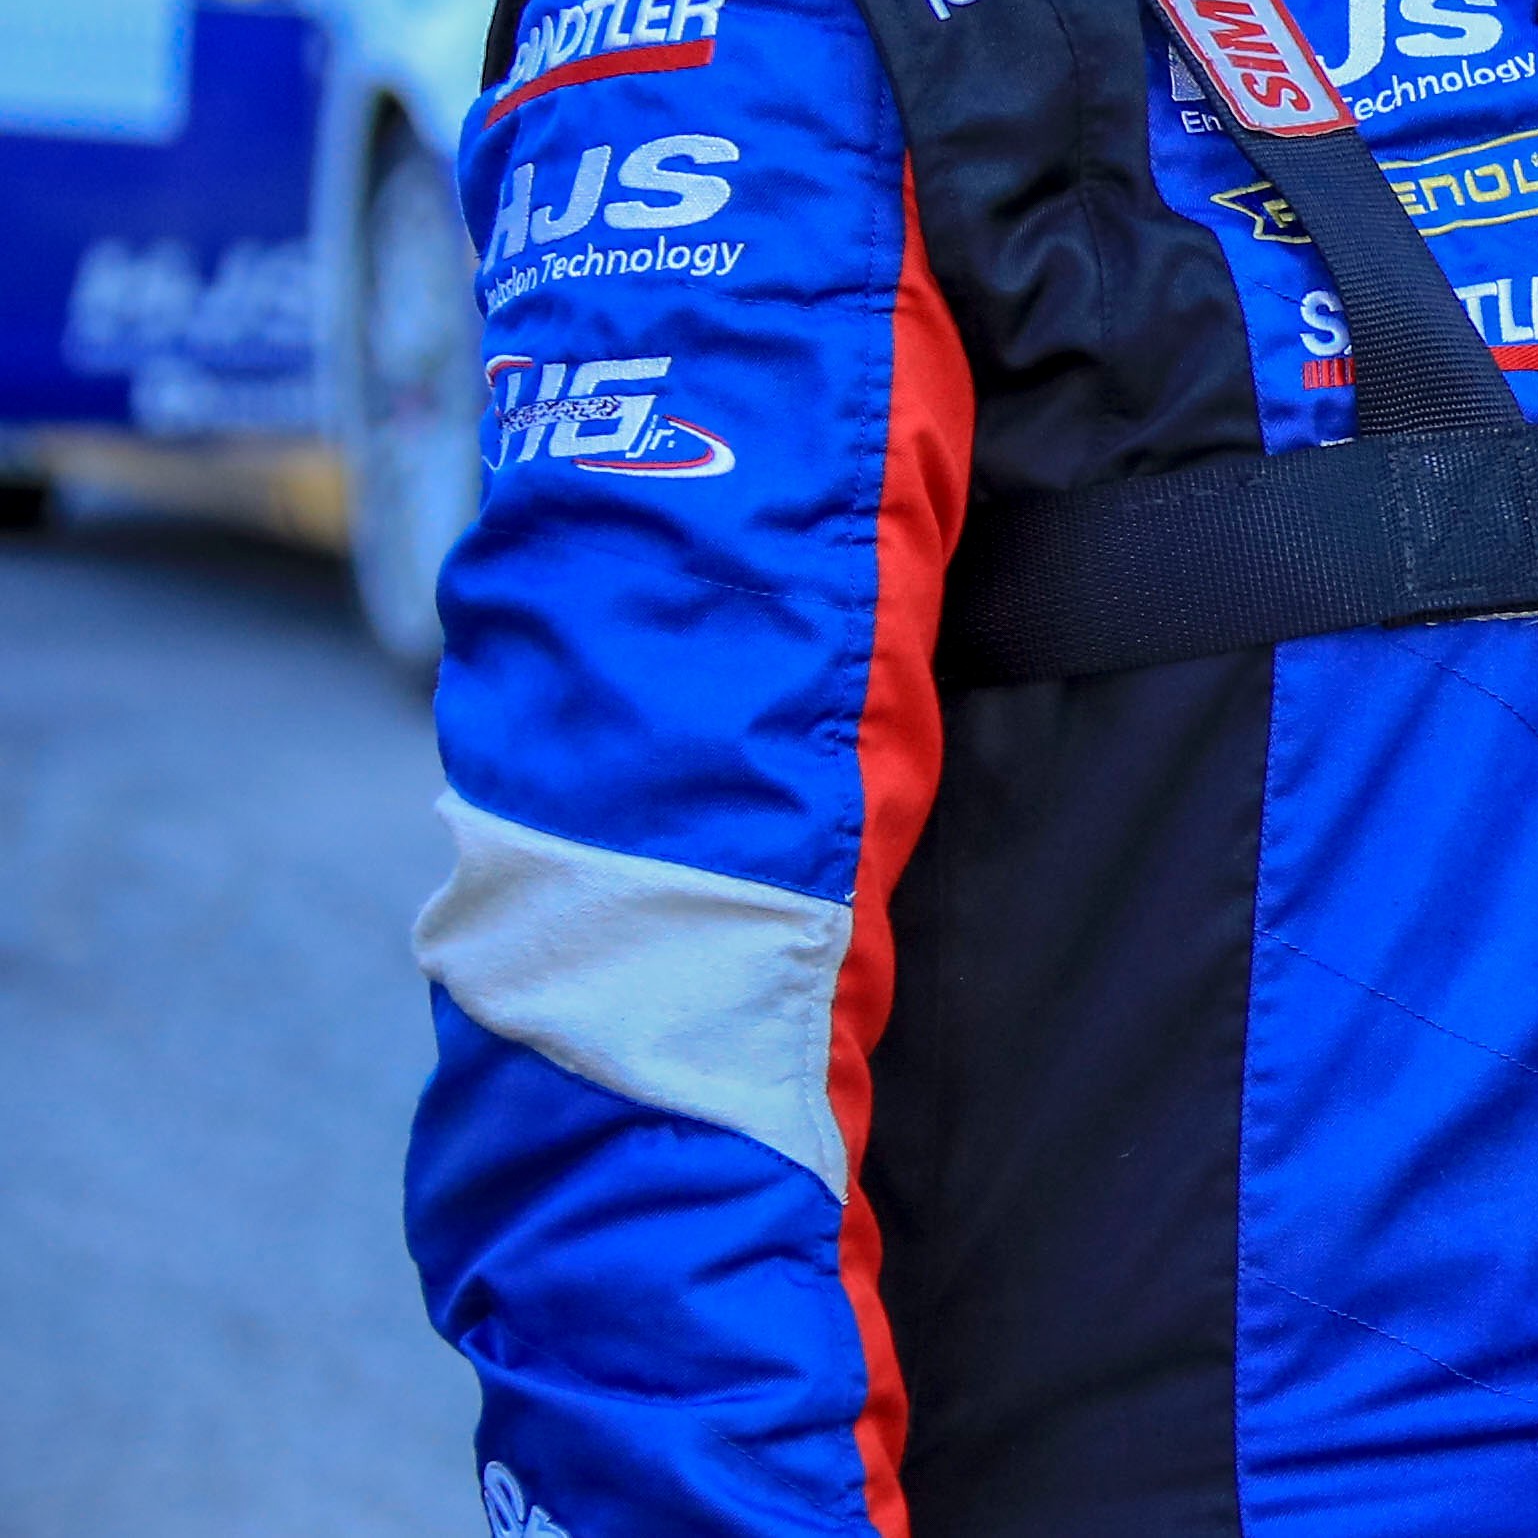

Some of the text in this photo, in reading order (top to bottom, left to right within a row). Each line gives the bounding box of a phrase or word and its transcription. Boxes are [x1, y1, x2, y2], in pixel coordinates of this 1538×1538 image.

[1342, 52, 1536, 120] echnology
[483, 134, 740, 275] HJS
[541, 235, 745, 283] Technology
